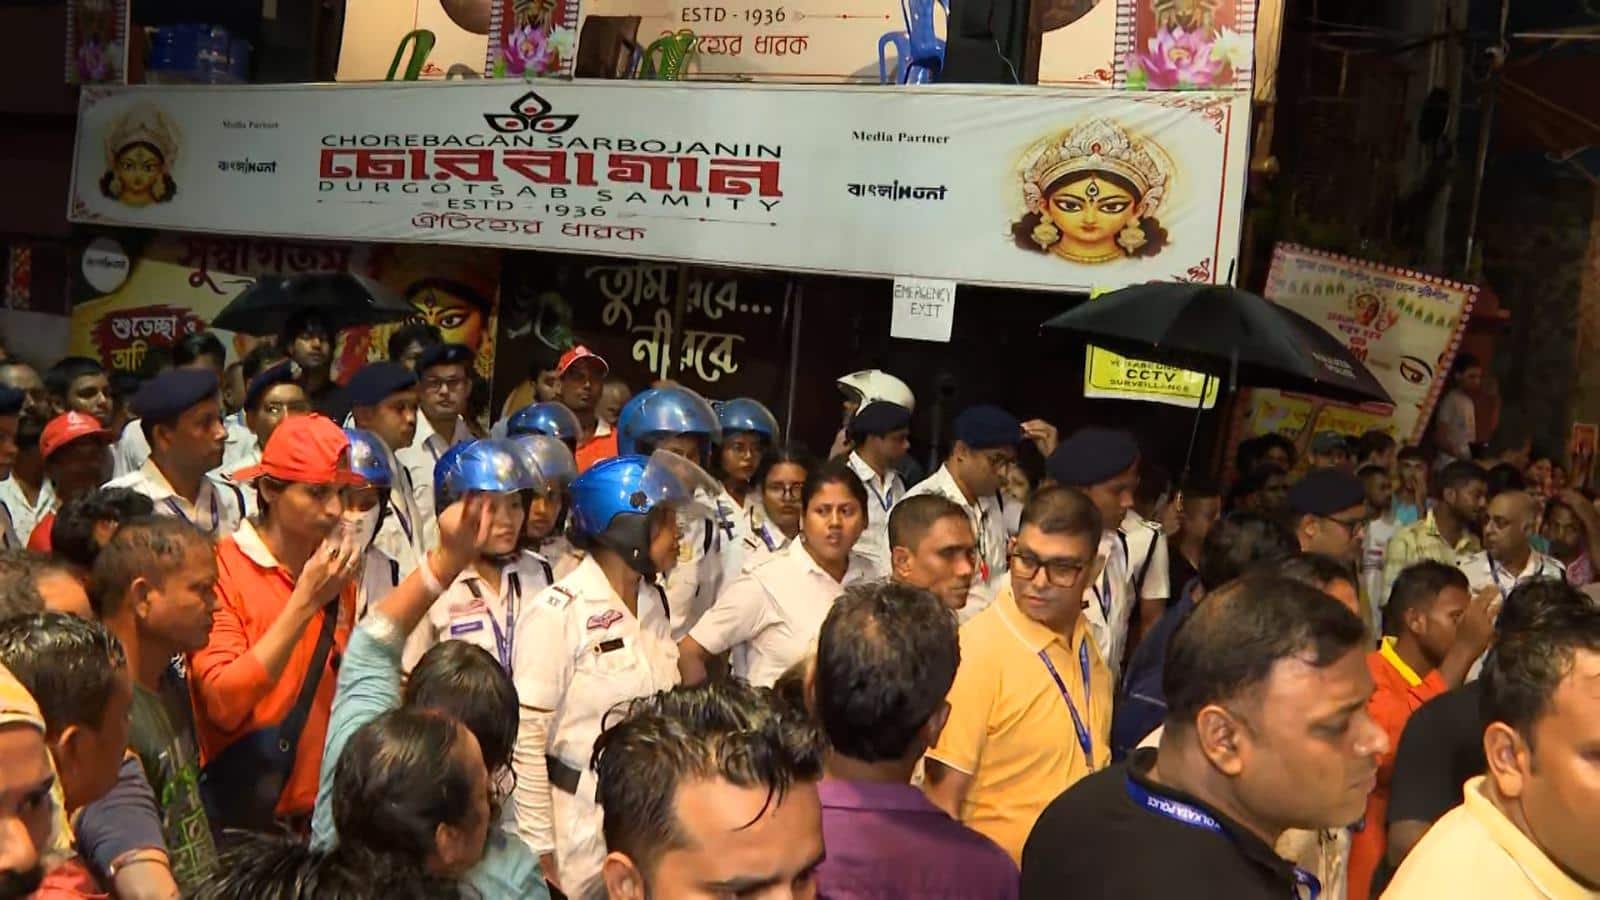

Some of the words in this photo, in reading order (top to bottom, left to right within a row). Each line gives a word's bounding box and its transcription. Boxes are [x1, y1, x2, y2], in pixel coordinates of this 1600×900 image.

[682, 7, 726, 22] ESTD
[744, 6, 786, 26] 1936
[754, 35, 809, 57] ধারক
[321, 134, 534, 148] CHOREBAGAN
[547, 135, 782, 159] SARBOJANIN
[852, 131, 893, 142] Media
[898, 132, 950, 144] Partner
[319, 149, 784, 198] চোরবাগান
[319, 180, 568, 200] DURGOTSAB
[597, 189, 781, 212] SAMITY
[447, 199, 514, 212] ESTD
[545, 204, 607, 217] 1936
[411, 212, 544, 234] ঐতিহ্যের
[561, 222, 647, 241] ধারক
[911, 302, 944, 318] EXIT
[112, 315, 177, 341] শুভেচ্ছা
[1109, 379, 1190, 392] SURVEILLNCE
[1126, 369, 1176, 382] CCTV
